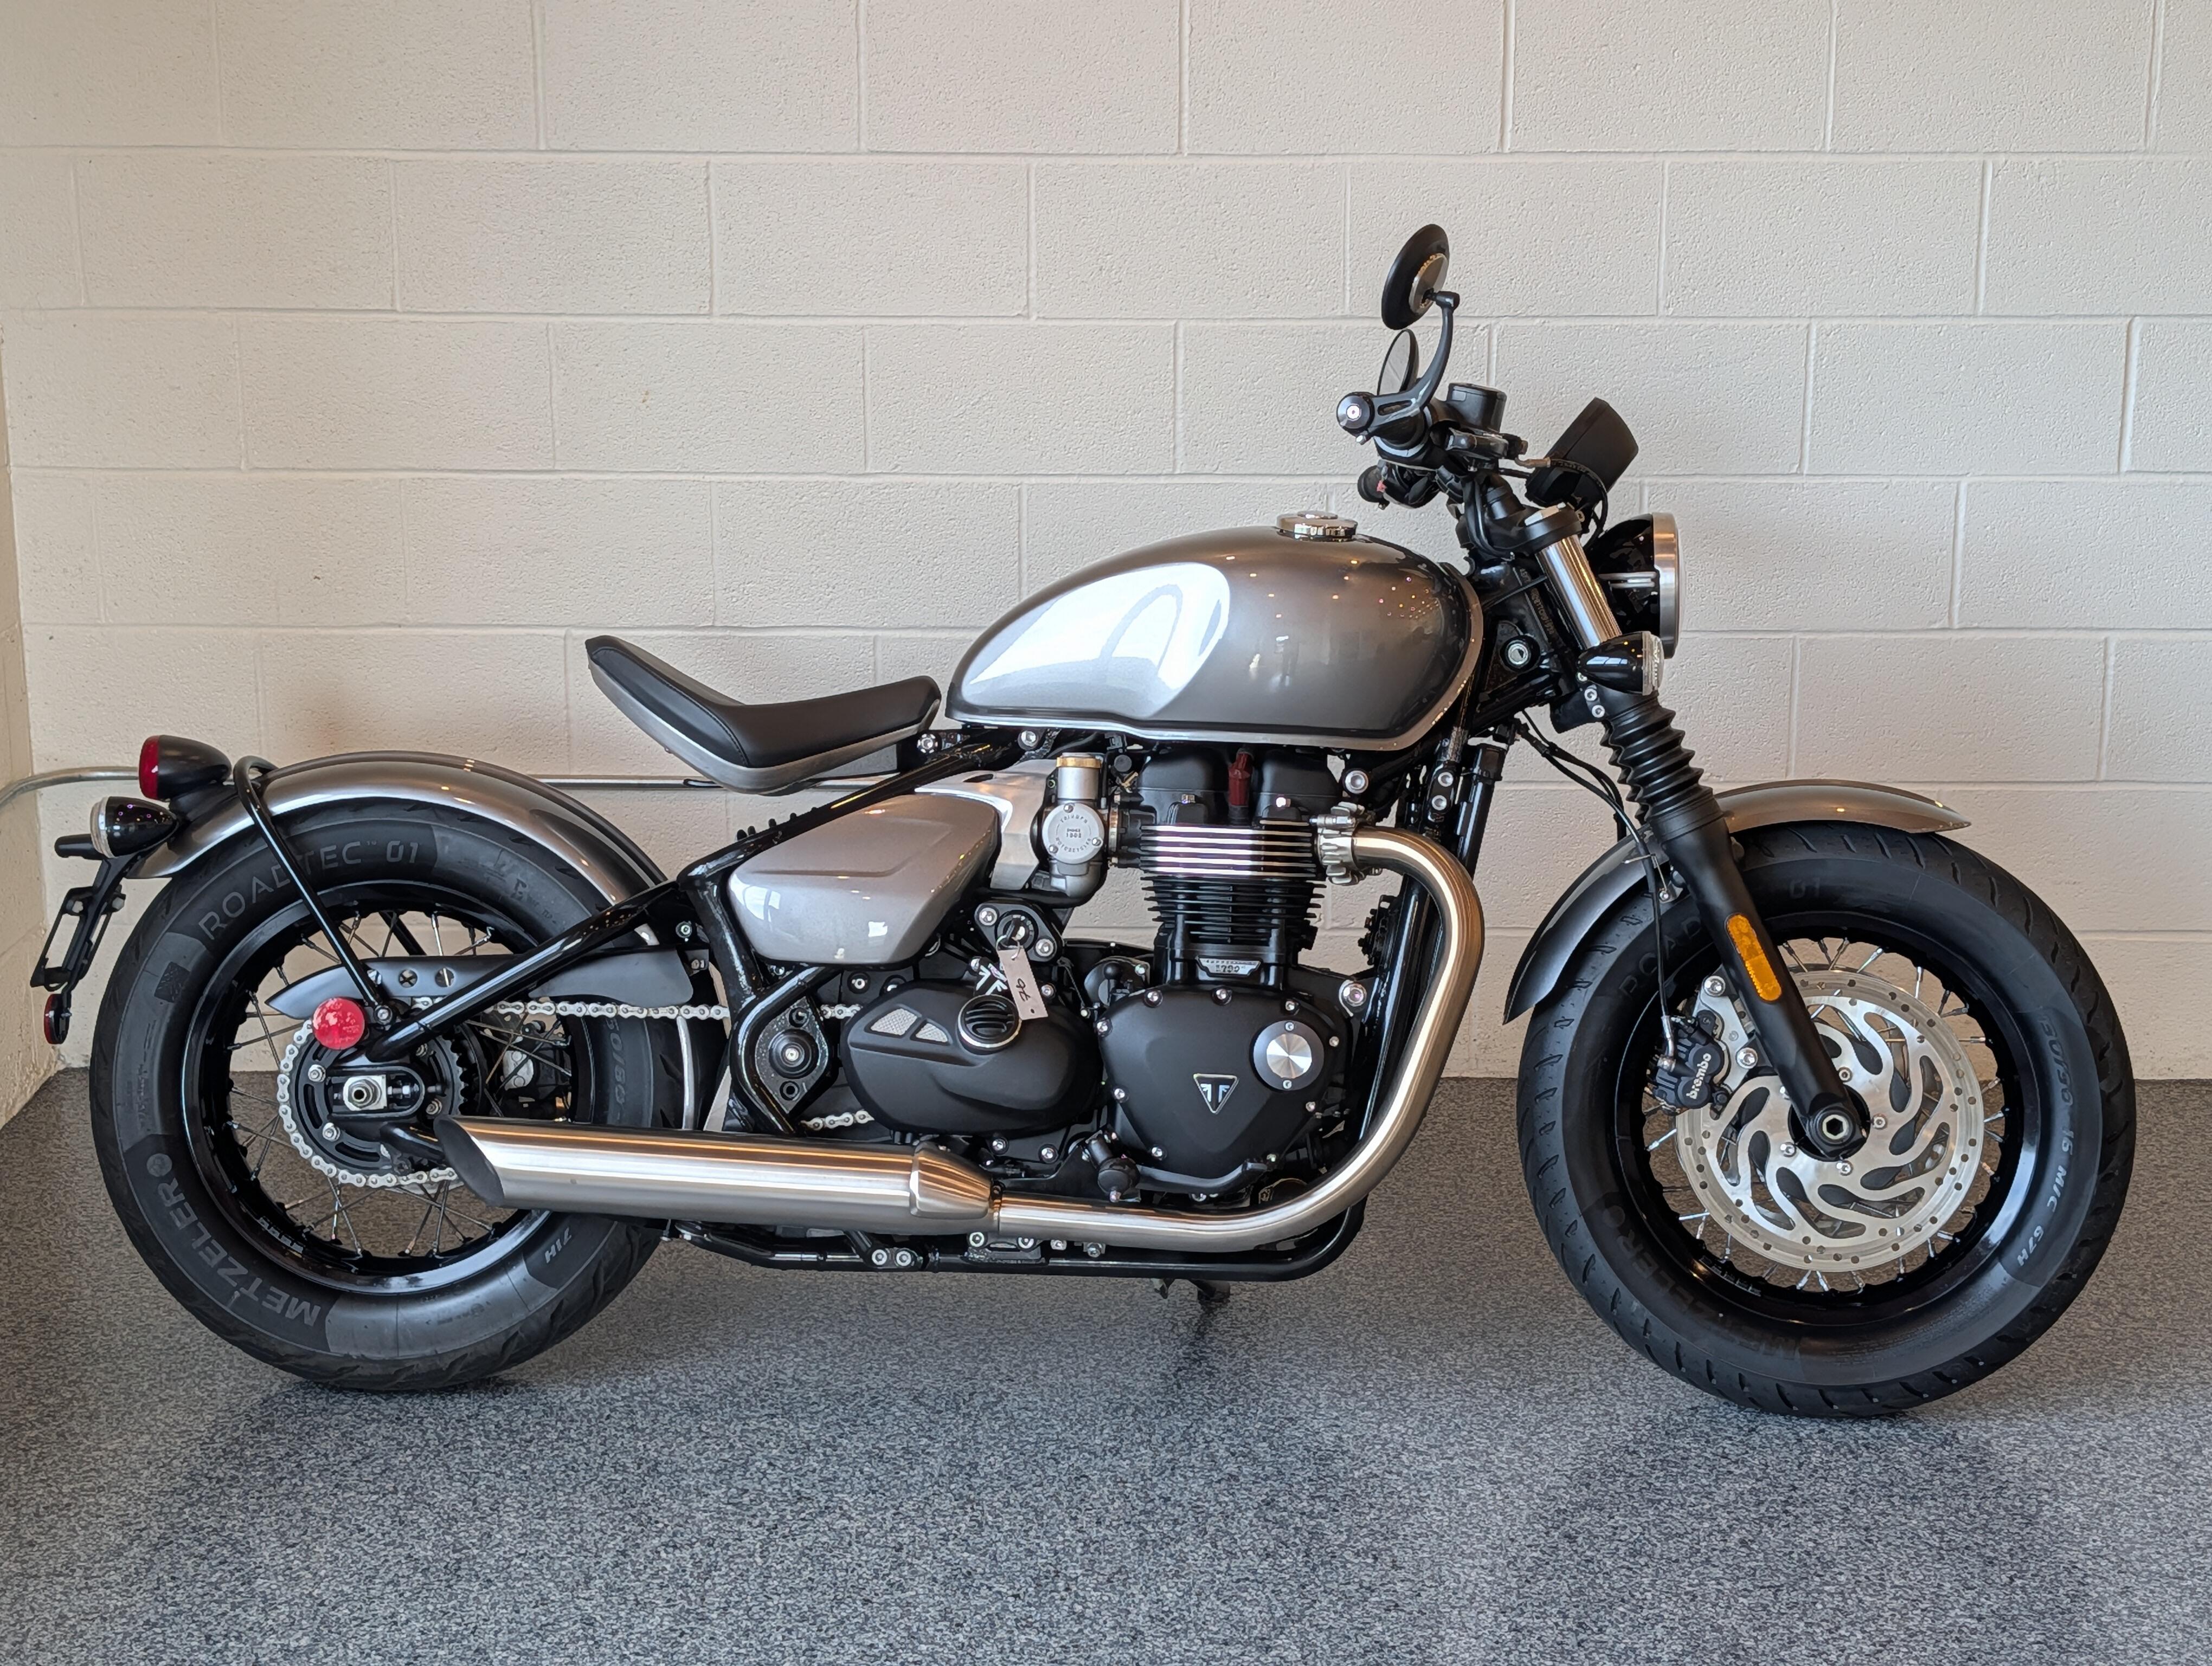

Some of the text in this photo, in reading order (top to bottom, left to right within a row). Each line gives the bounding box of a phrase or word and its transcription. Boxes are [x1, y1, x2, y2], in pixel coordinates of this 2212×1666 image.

[1686, 1053, 1712, 1100] brembo
[157, 1177, 321, 1328] METZELER
[2017, 1225, 2044, 1266] 67H
